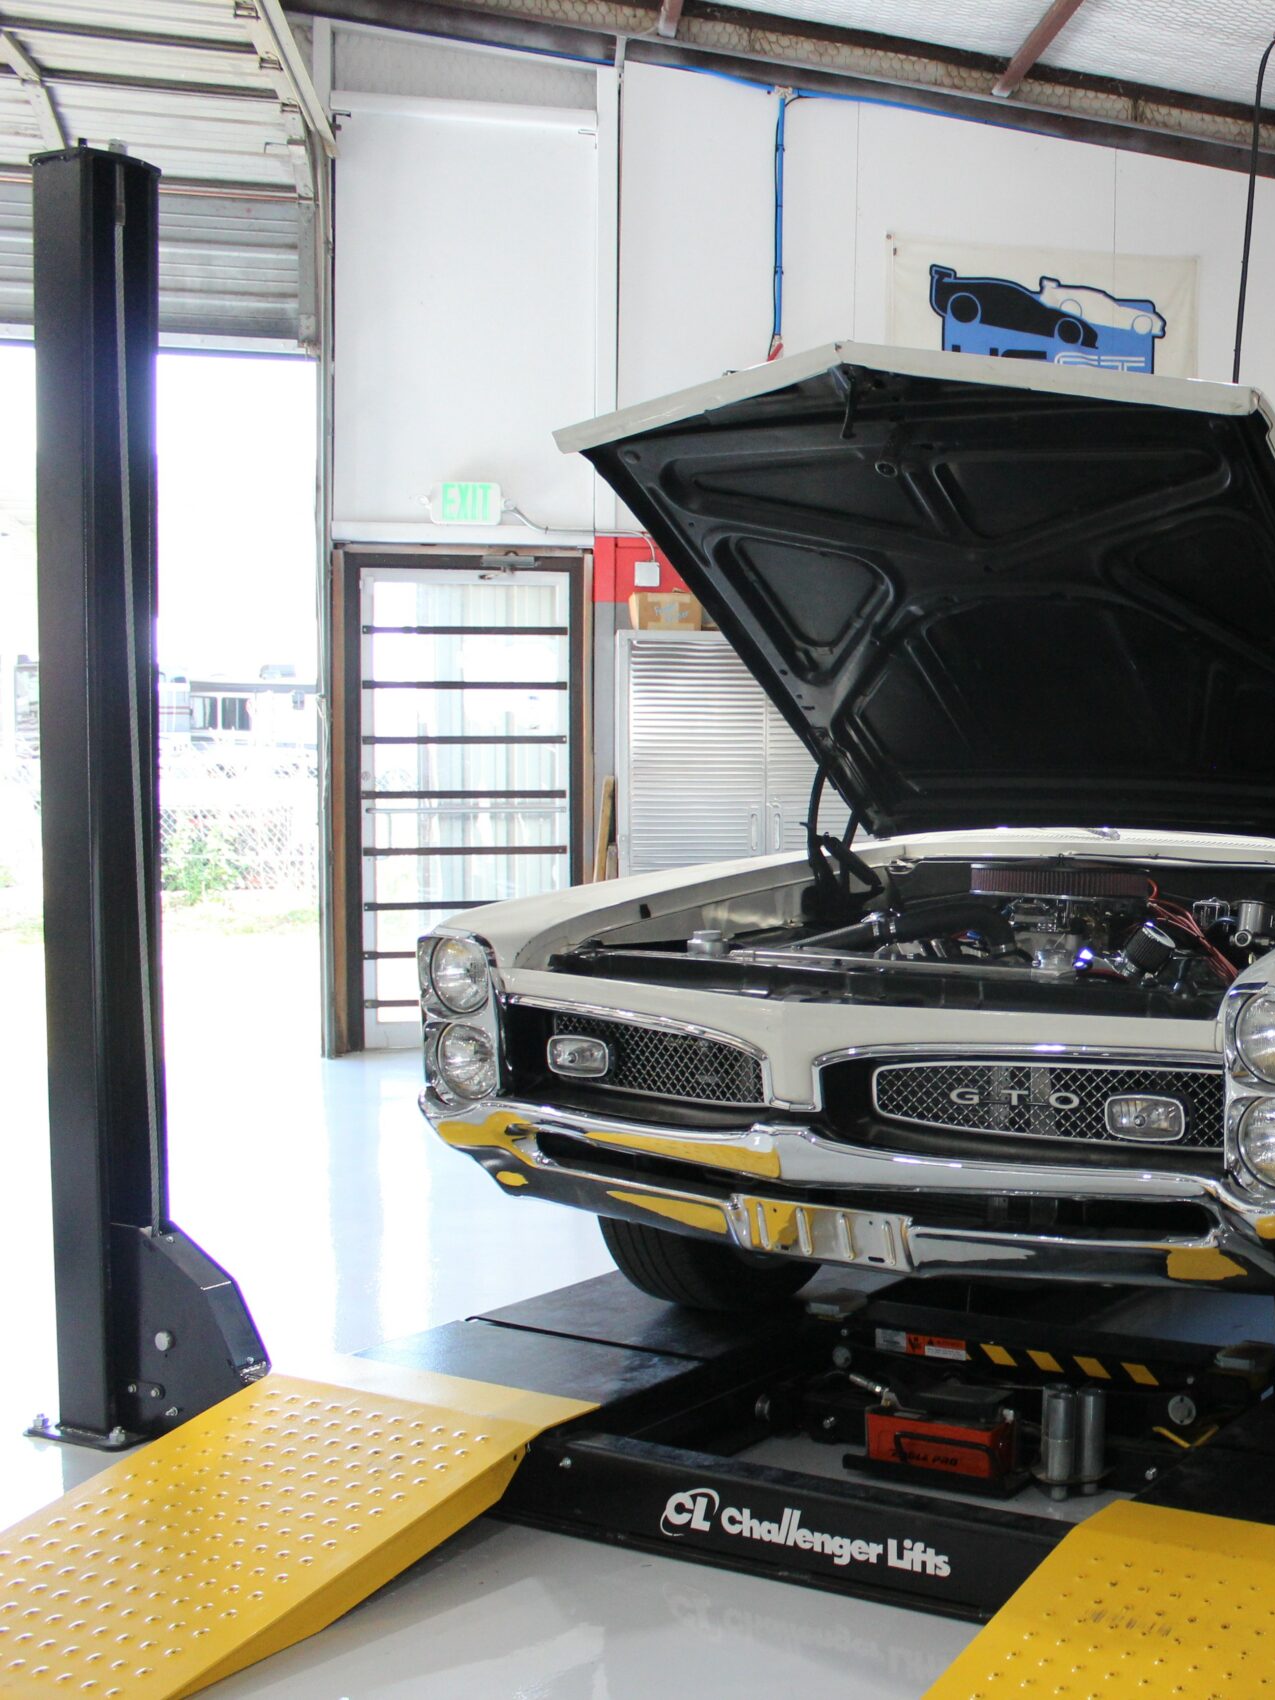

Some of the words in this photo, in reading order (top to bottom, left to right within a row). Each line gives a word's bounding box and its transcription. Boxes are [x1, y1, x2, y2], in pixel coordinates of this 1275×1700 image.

[442, 483, 491, 521] EXIT
[720, 1507, 883, 1566] Challenger
[887, 1538, 951, 1577] Lifts
